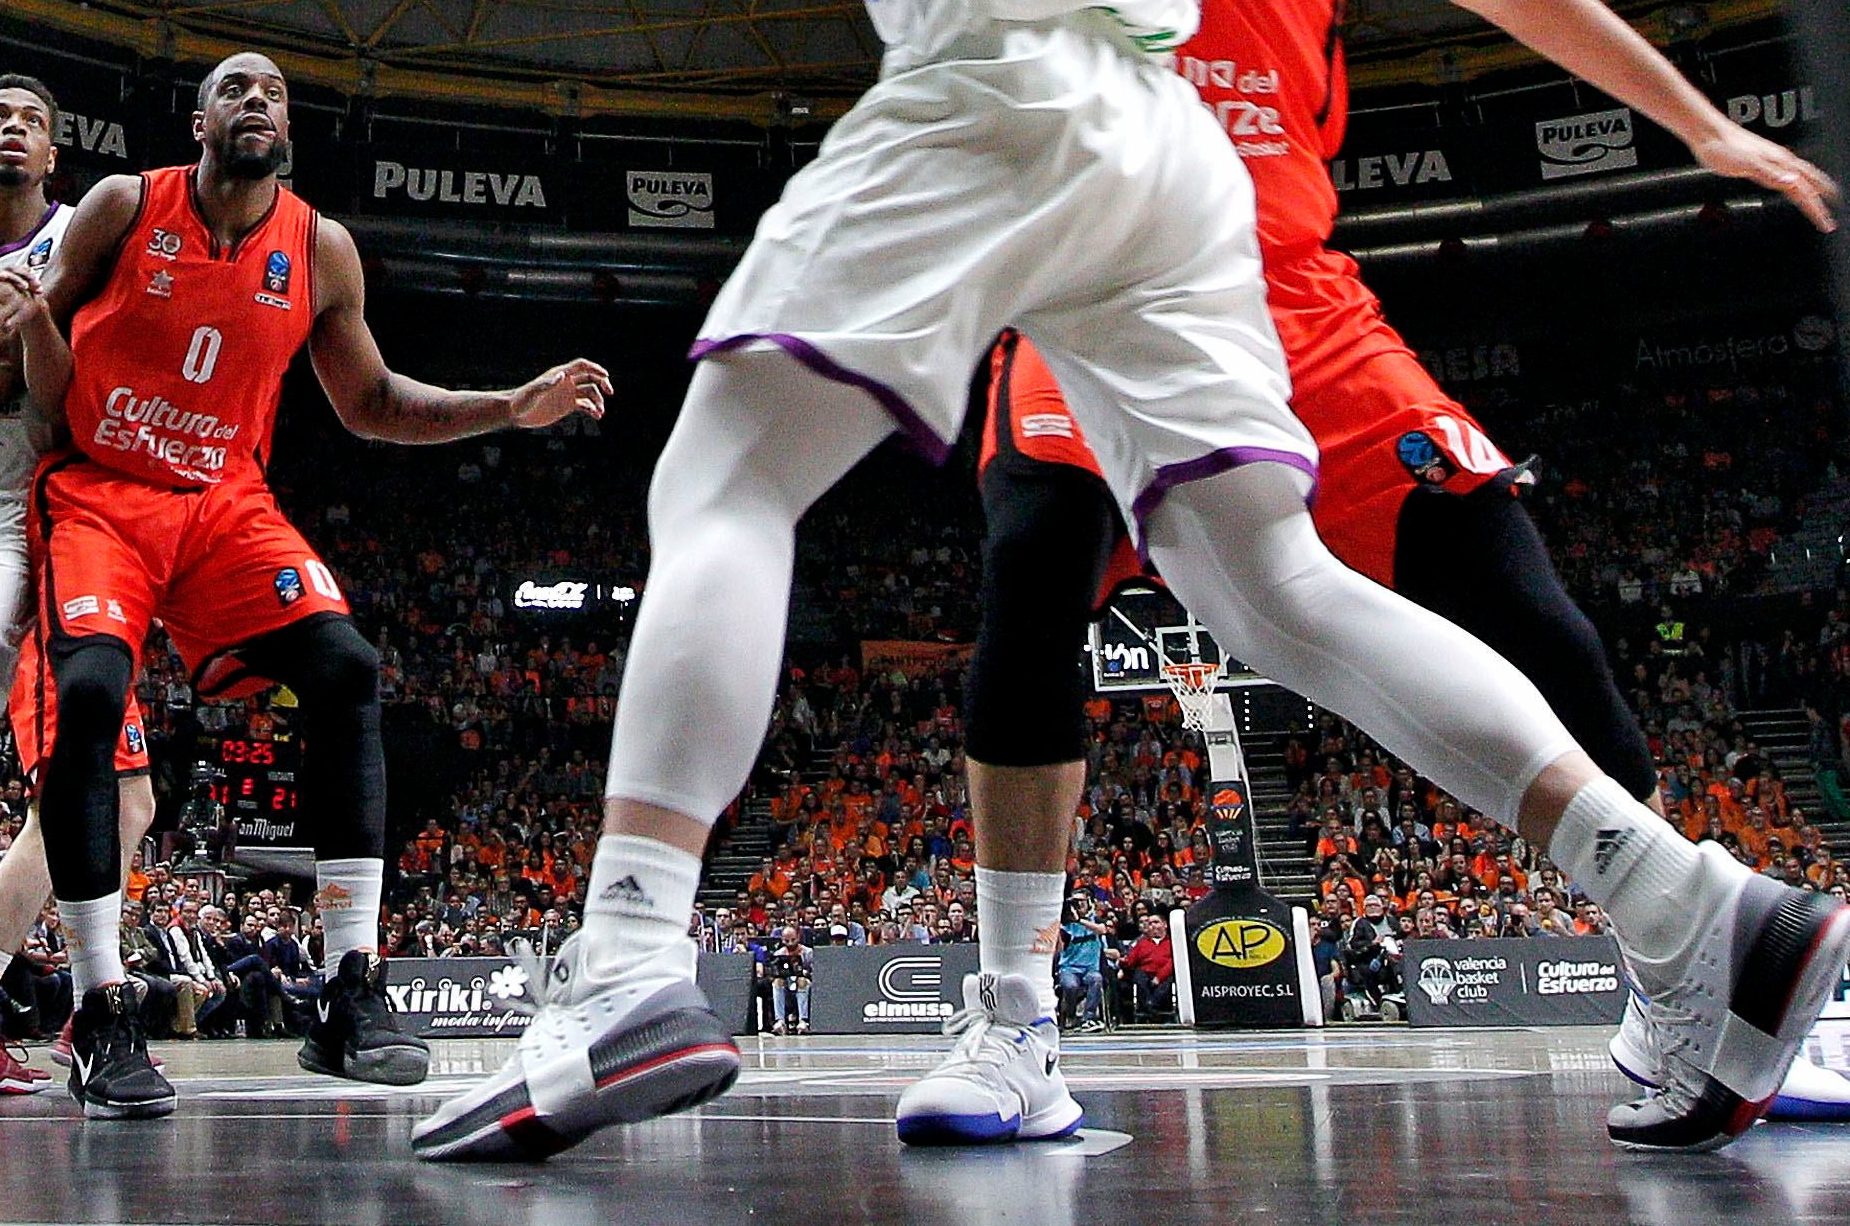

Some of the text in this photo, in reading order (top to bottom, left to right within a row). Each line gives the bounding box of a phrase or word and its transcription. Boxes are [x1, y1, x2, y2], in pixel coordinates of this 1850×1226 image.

[53, 110, 128, 159] EVA
[1542, 118, 1629, 145] PULEVA
[373, 160, 546, 209] PULEVA
[1333, 150, 1453, 192] LEVA
[631, 177, 708, 195] PULEVA
[148, 228, 182, 255] 30
[182, 325, 223, 384] 0
[105, 386, 240, 441] Cultura del
[93, 418, 227, 471] Esfuerzo
[304, 559, 342, 602] 0
[272, 788, 297, 810] 21
[1212, 925, 1271, 961] AP
[1454, 956, 1508, 971] valencia
[1538, 960, 1616, 977] Cultura del
[1456, 970, 1500, 985] basket
[1537, 975, 1619, 995] Esfuerzo
[1456, 984, 1489, 999] club
[431, 1010, 536, 1033] moda infan
[863, 1000, 955, 1018] elmusa
